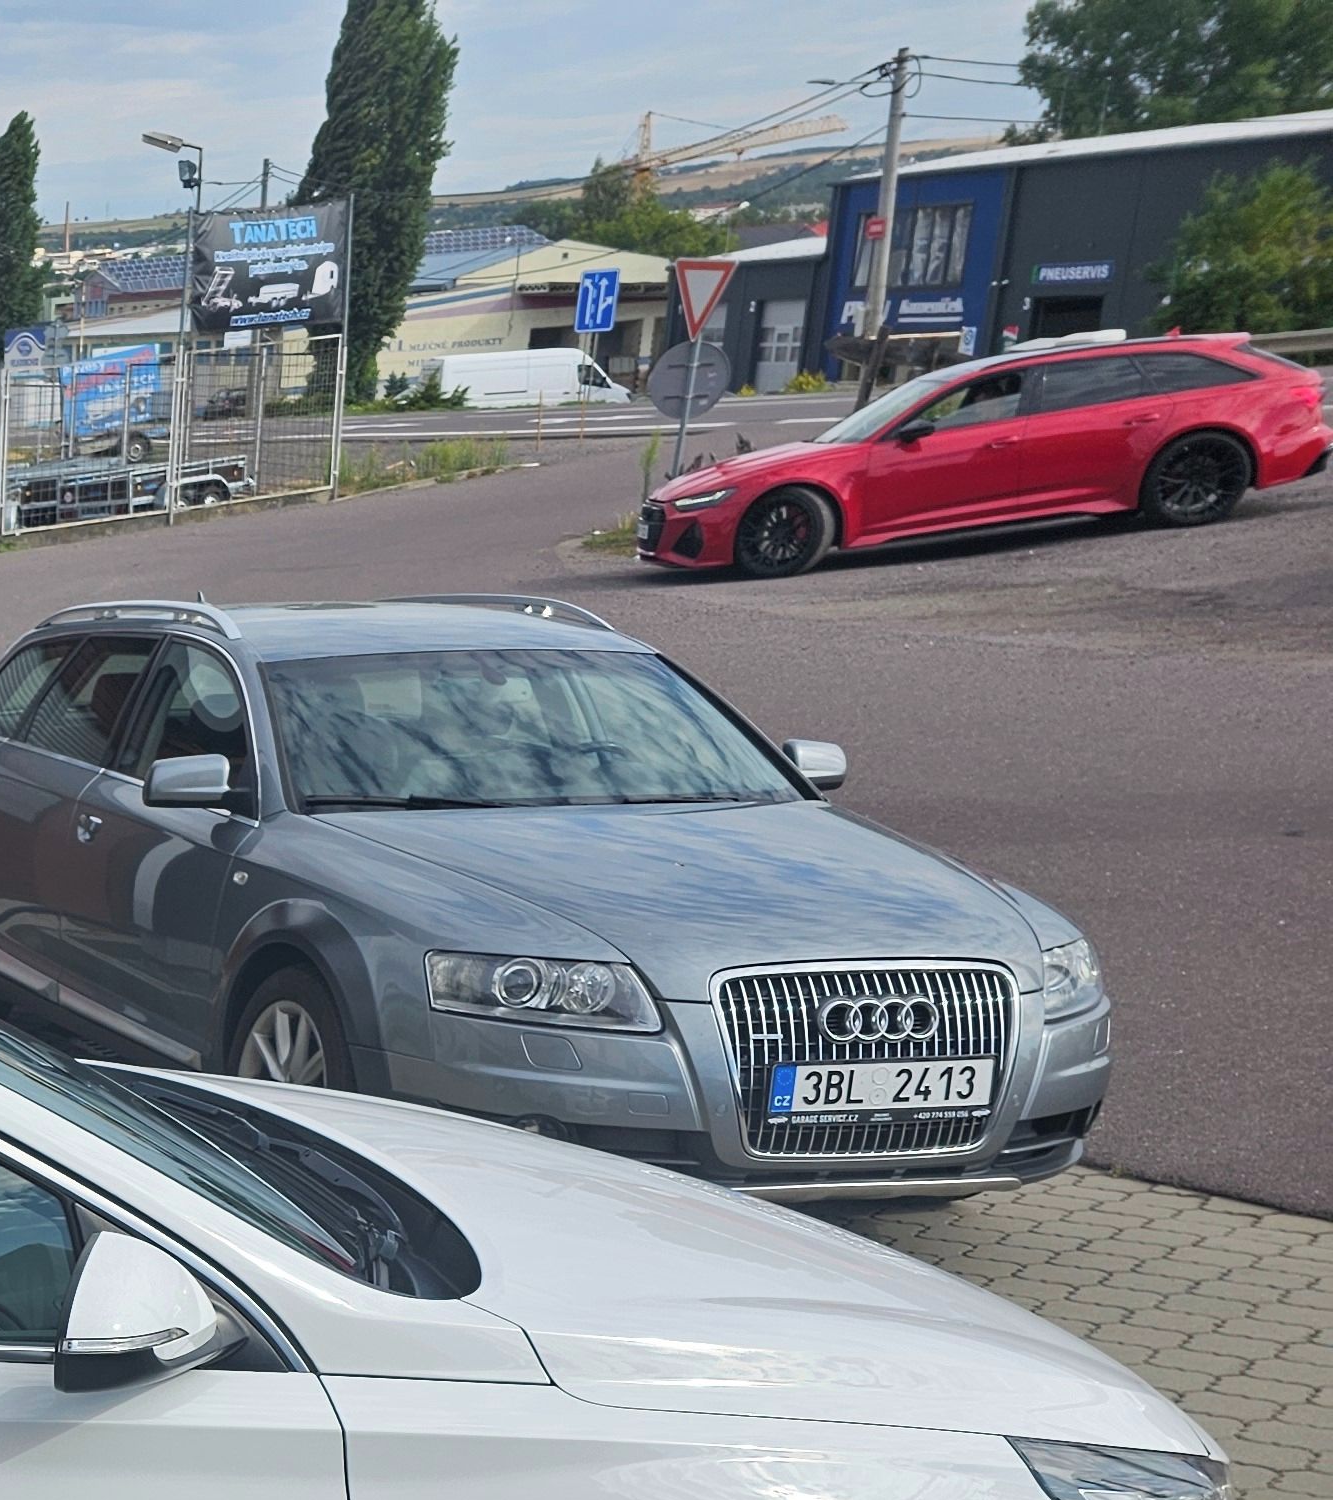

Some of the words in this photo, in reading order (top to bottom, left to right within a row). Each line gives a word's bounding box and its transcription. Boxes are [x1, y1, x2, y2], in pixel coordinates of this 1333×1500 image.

[1039, 264, 1109, 280] PNEUSERVIS
[451, 337, 503, 348] PRODUKTY
[802, 1070, 863, 1105] 3BL
[892, 1065, 976, 1103] 2413
[774, 1095, 791, 1107] CZ
